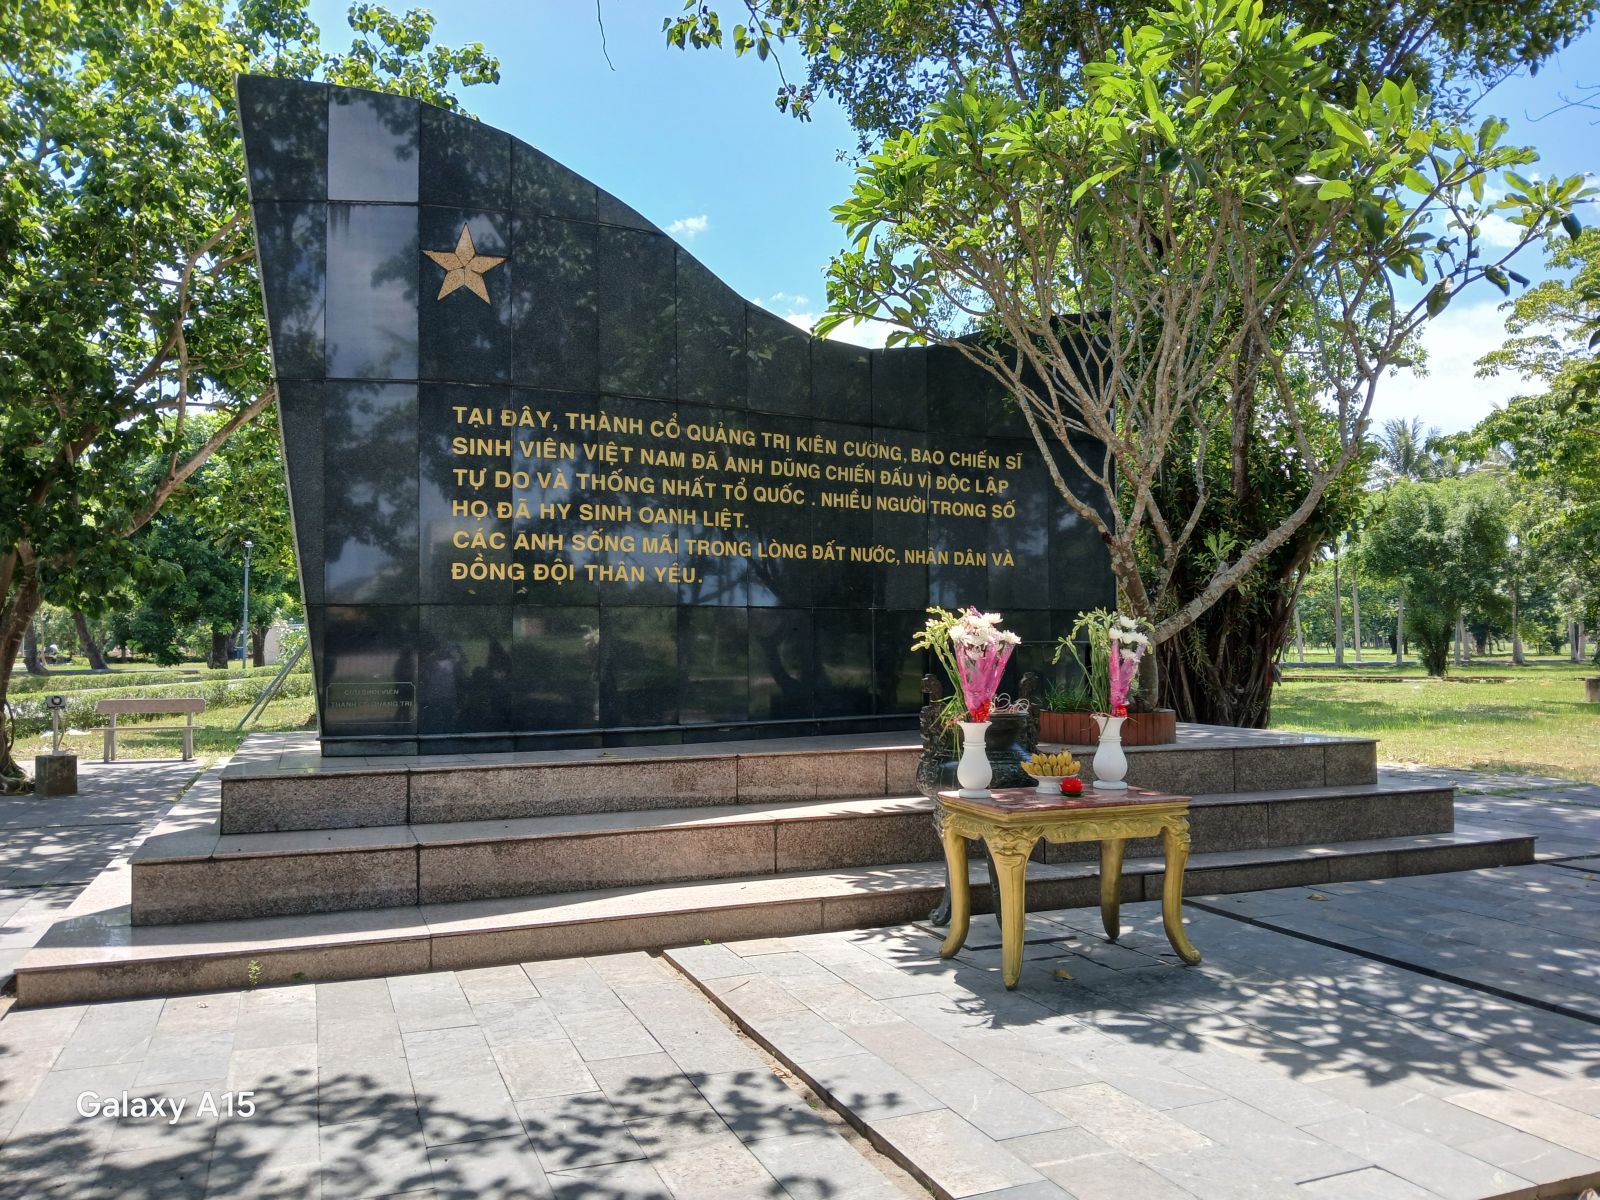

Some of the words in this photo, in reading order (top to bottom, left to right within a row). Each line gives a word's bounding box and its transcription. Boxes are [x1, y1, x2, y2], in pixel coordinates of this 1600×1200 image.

[452, 406, 492, 428] TẠI
[501, 405, 558, 431] ĐÂY,
[565, 410, 643, 435] THÀNH
[650, 412, 681, 439] CỔ
[686, 421, 756, 447] QUẢNG
[761, 432, 790, 453] TRỊ
[796, 435, 837, 454] KIÊN
[844, 440, 907, 464] CƯỜNG,
[911, 448, 945, 465] BAO
[949, 449, 1000, 469] CHIẾN
[1006, 452, 1024, 470] SĨ
[452, 437, 511, 456] SINH
[520, 437, 575, 460] VIÊN
[583, 441, 633, 465] VIỆT
[640, 448, 685, 468] NAM
[692, 451, 719, 471] ĐÃ
[725, 454, 763, 474] ANH
[771, 458, 821, 479] DŨNG
[825, 463, 875, 484] CHIẾN
[880, 466, 913, 487] ĐẤU
[918, 471, 931, 489] VÌ
[936, 474, 970, 494] ĐỘC
[975, 476, 1009, 496] LẬP
[452, 467, 487, 490] TỰ
[494, 471, 530, 489] DO
[537, 470, 569, 490] VÀ
[576, 468, 655, 493] THỐNG
[662, 475, 716, 498] NHẤT
[722, 477, 748, 501] TỔ
[753, 483, 805, 504] QUỐC
[821, 488, 871, 510] NHIỀU
[877, 495, 927, 514] NGƯỜI
[930, 500, 986, 518] TRONG
[992, 499, 1016, 519] SỐ
[452, 500, 488, 521] HỌ
[496, 498, 531, 520] ĐÃ
[540, 504, 572, 520] HY
[579, 504, 632, 522] SINH
[639, 506, 697, 527] OANH
[703, 508, 749, 531] LIỆT.
[451, 553, 525, 581] ĐỒNG
[532, 558, 575, 585] ĐỘI
[584, 561, 645, 583] THÂN
[654, 562, 703, 584] YÊU.
[452, 528, 506, 549] CÁC
[572, 528, 635, 553] SỐNG
[642, 534, 679, 554] MÃI
[685, 539, 752, 558] TRONG
[758, 539, 807, 559] LÒNG
[812, 540, 845, 561] ĐẤT
[850, 544, 900, 566] NƯỚC,
[905, 547, 949, 565] NHÂN
[954, 549, 987, 566] DÂN
[992, 549, 1015, 566] VÀ
